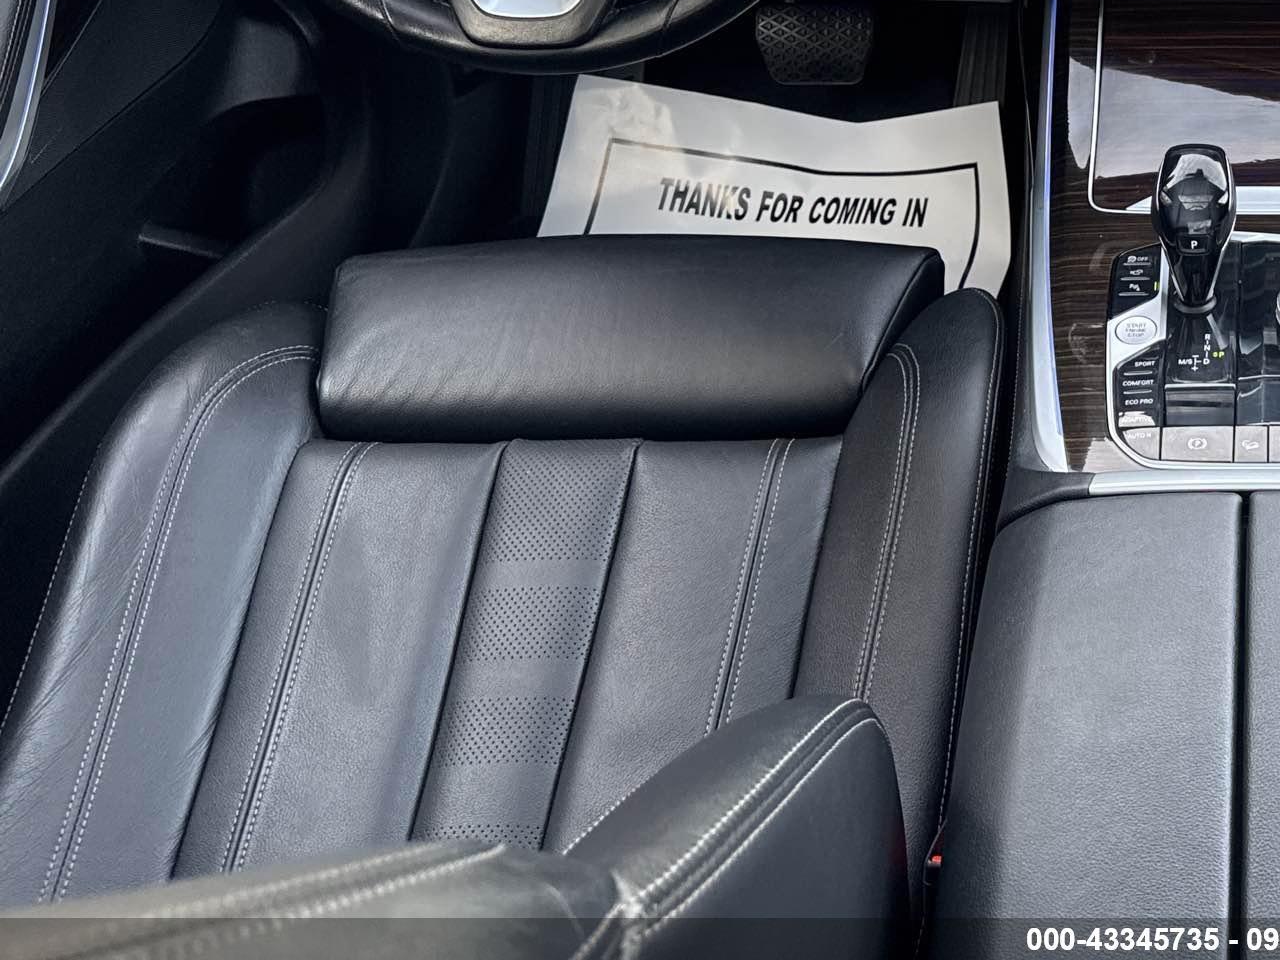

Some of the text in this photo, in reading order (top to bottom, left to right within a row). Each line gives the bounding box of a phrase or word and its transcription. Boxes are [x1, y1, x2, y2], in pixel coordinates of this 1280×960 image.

[658, 177, 928, 227] THANKS FOR COMING IN
[1190, 240, 1198, 249] P
